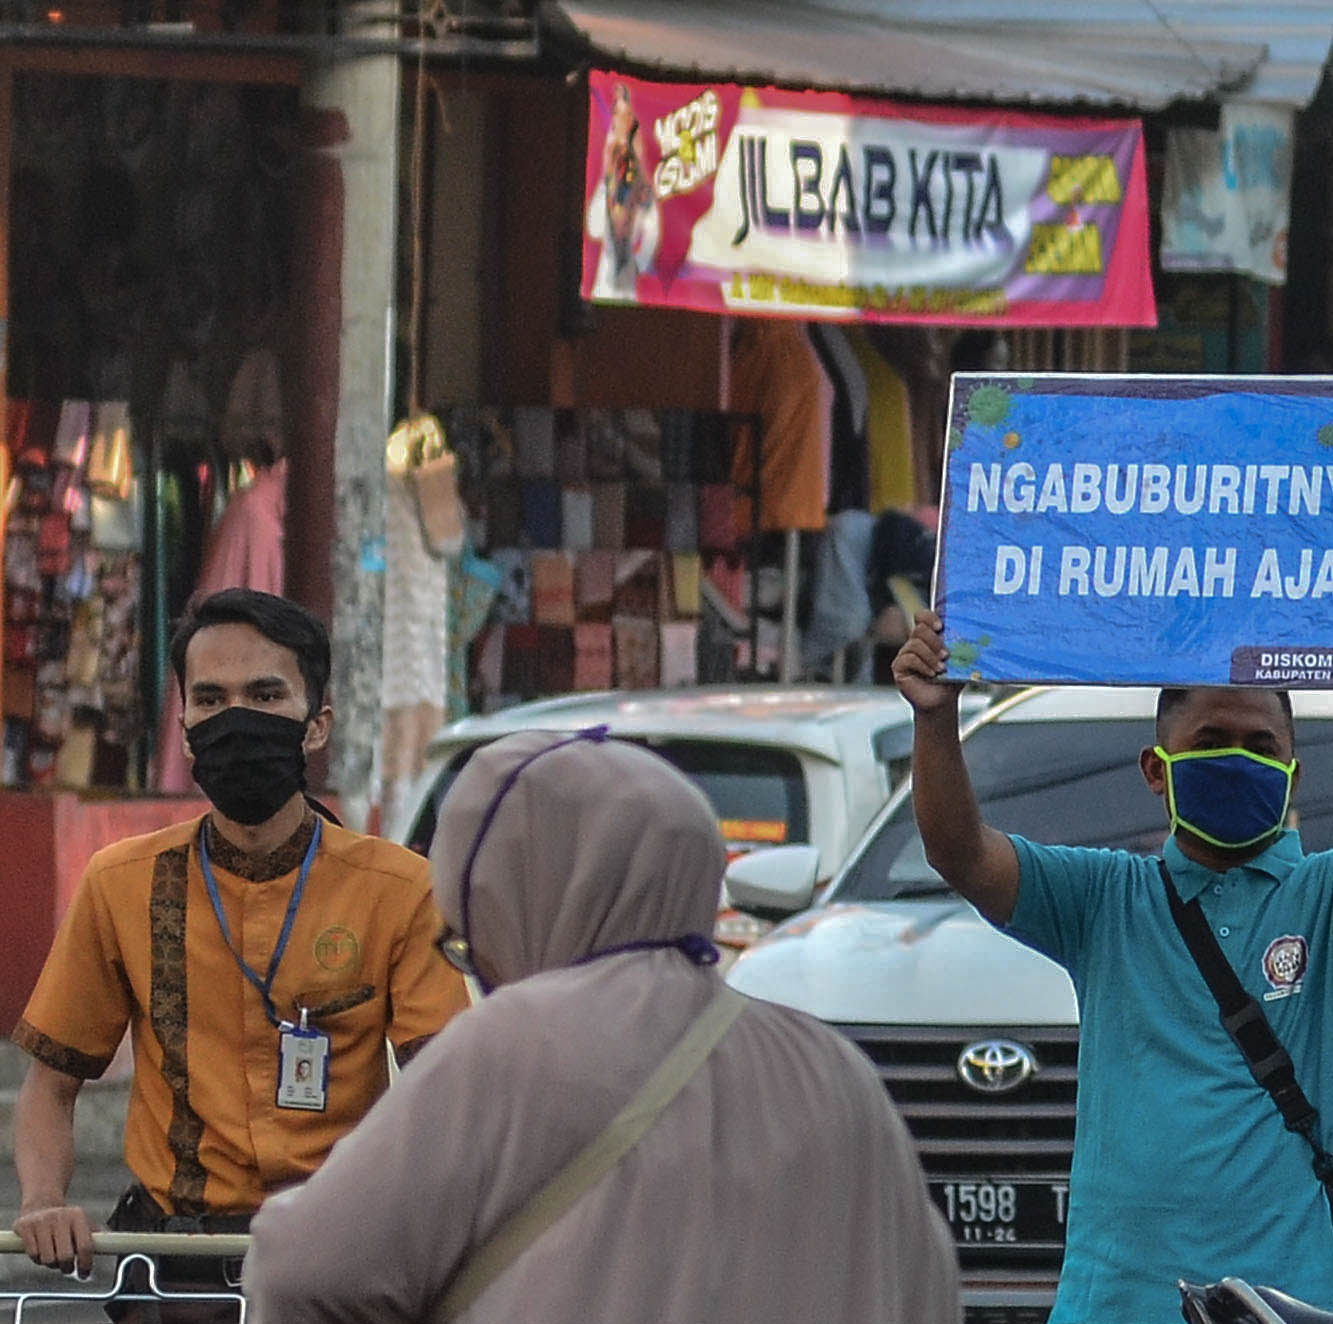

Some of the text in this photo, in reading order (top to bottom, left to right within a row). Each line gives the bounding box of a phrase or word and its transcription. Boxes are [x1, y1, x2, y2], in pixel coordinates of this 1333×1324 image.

[731, 134, 898, 249] JILBAB
[906, 147, 1006, 242] KITA
[993, 545, 1044, 597] DI
[1058, 546, 1238, 599] RUMAH
[1255, 669, 1331, 680] KABUPATEN
[944, 1184, 1016, 1223] 1598
